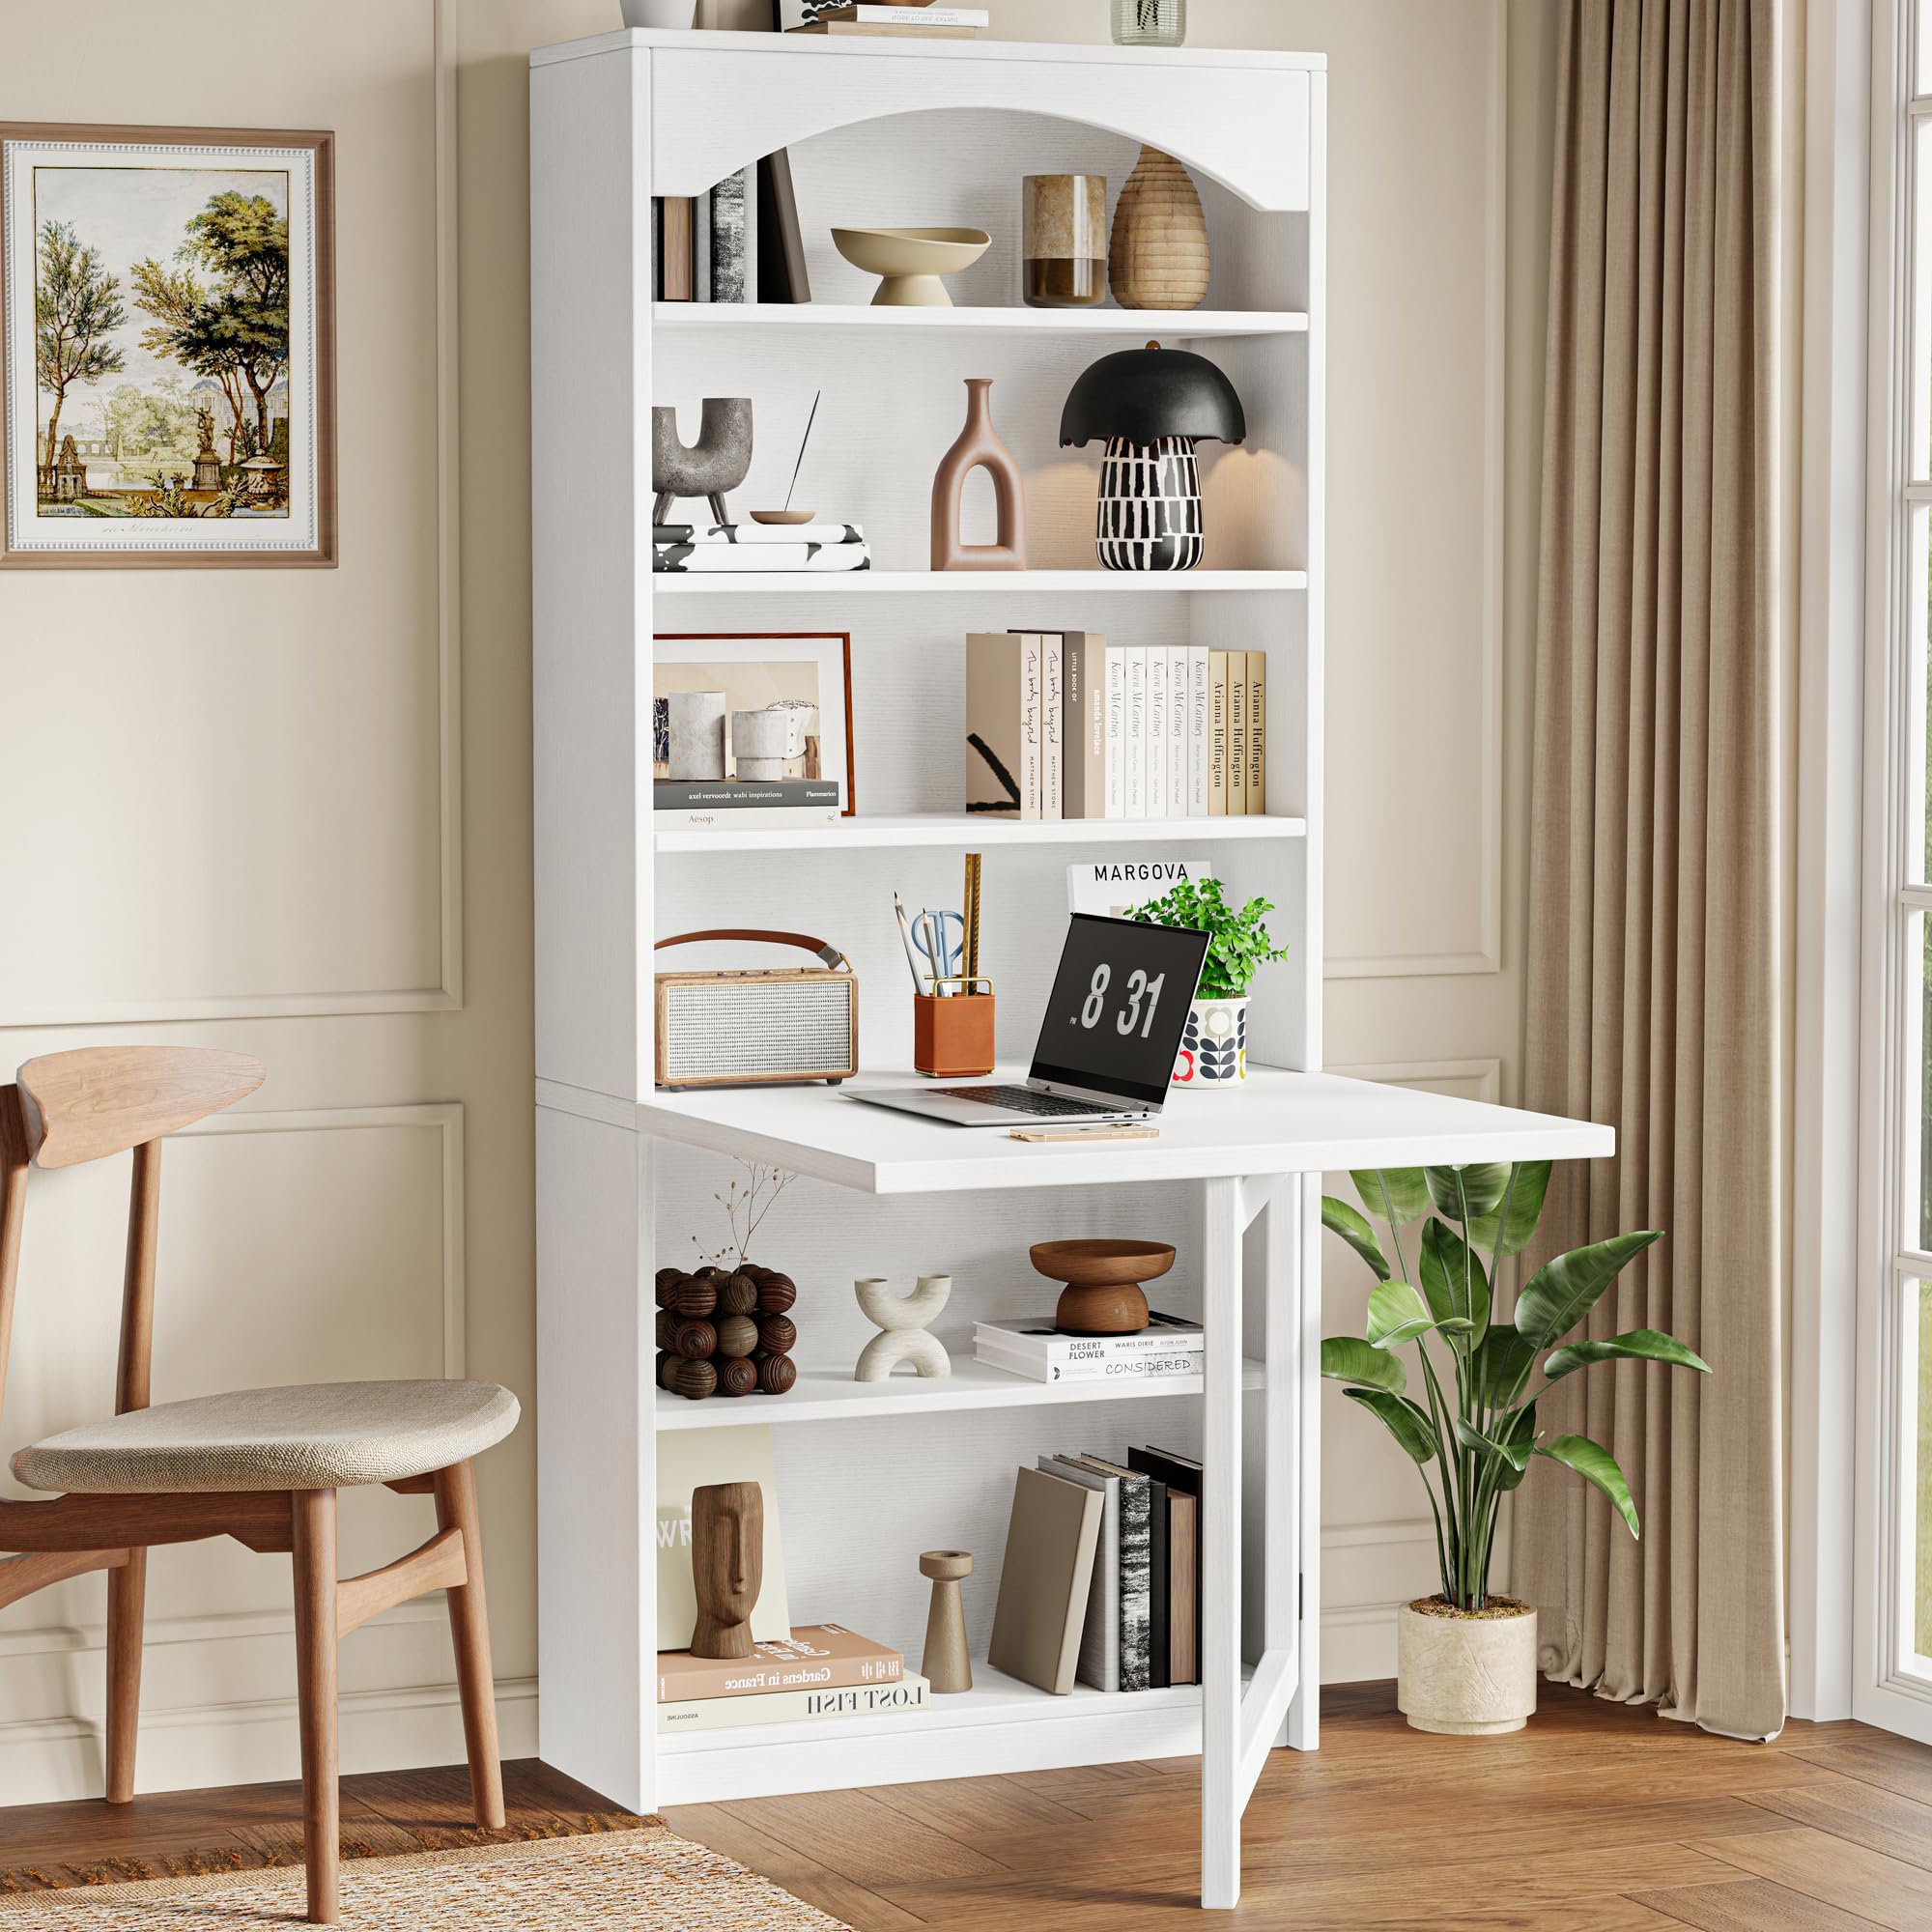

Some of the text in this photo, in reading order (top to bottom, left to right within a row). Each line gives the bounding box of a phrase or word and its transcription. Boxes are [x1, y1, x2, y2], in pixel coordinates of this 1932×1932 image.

[1111, 662, 1121, 688] Karen
[1131, 661, 1142, 688] Karen
[1152, 661, 1163, 687] Karen
[1174, 661, 1184, 687] Karen
[1195, 661, 1206, 686] Karen
[1022, 650, 1039, 744] The body beyond
[1043, 650, 1061, 744] The body beyond
[1107, 691, 1121, 738] McCartney
[1128, 690, 1142, 738] McCartney
[1150, 690, 1163, 737] McCartney
[1171, 690, 1184, 737] McCartney
[1192, 690, 1206, 736] McCartney
[1211, 681, 1224, 787] Arianna Huffington
[1231, 681, 1243, 787] Arianna Huffington
[1250, 681, 1263, 787] Arianna Huffington
[749, 791, 782, 800] inspirations
[1094, 864, 1188, 881] MARGOVA
[1081, 963, 1111, 1029] 8
[1116, 969, 1166, 1038] 31
[1068, 1350, 1105, 1360] FLOWER
[1069, 1342, 1101, 1350] DESERT
[1105, 1359, 1191, 1375] CONSIDERED
